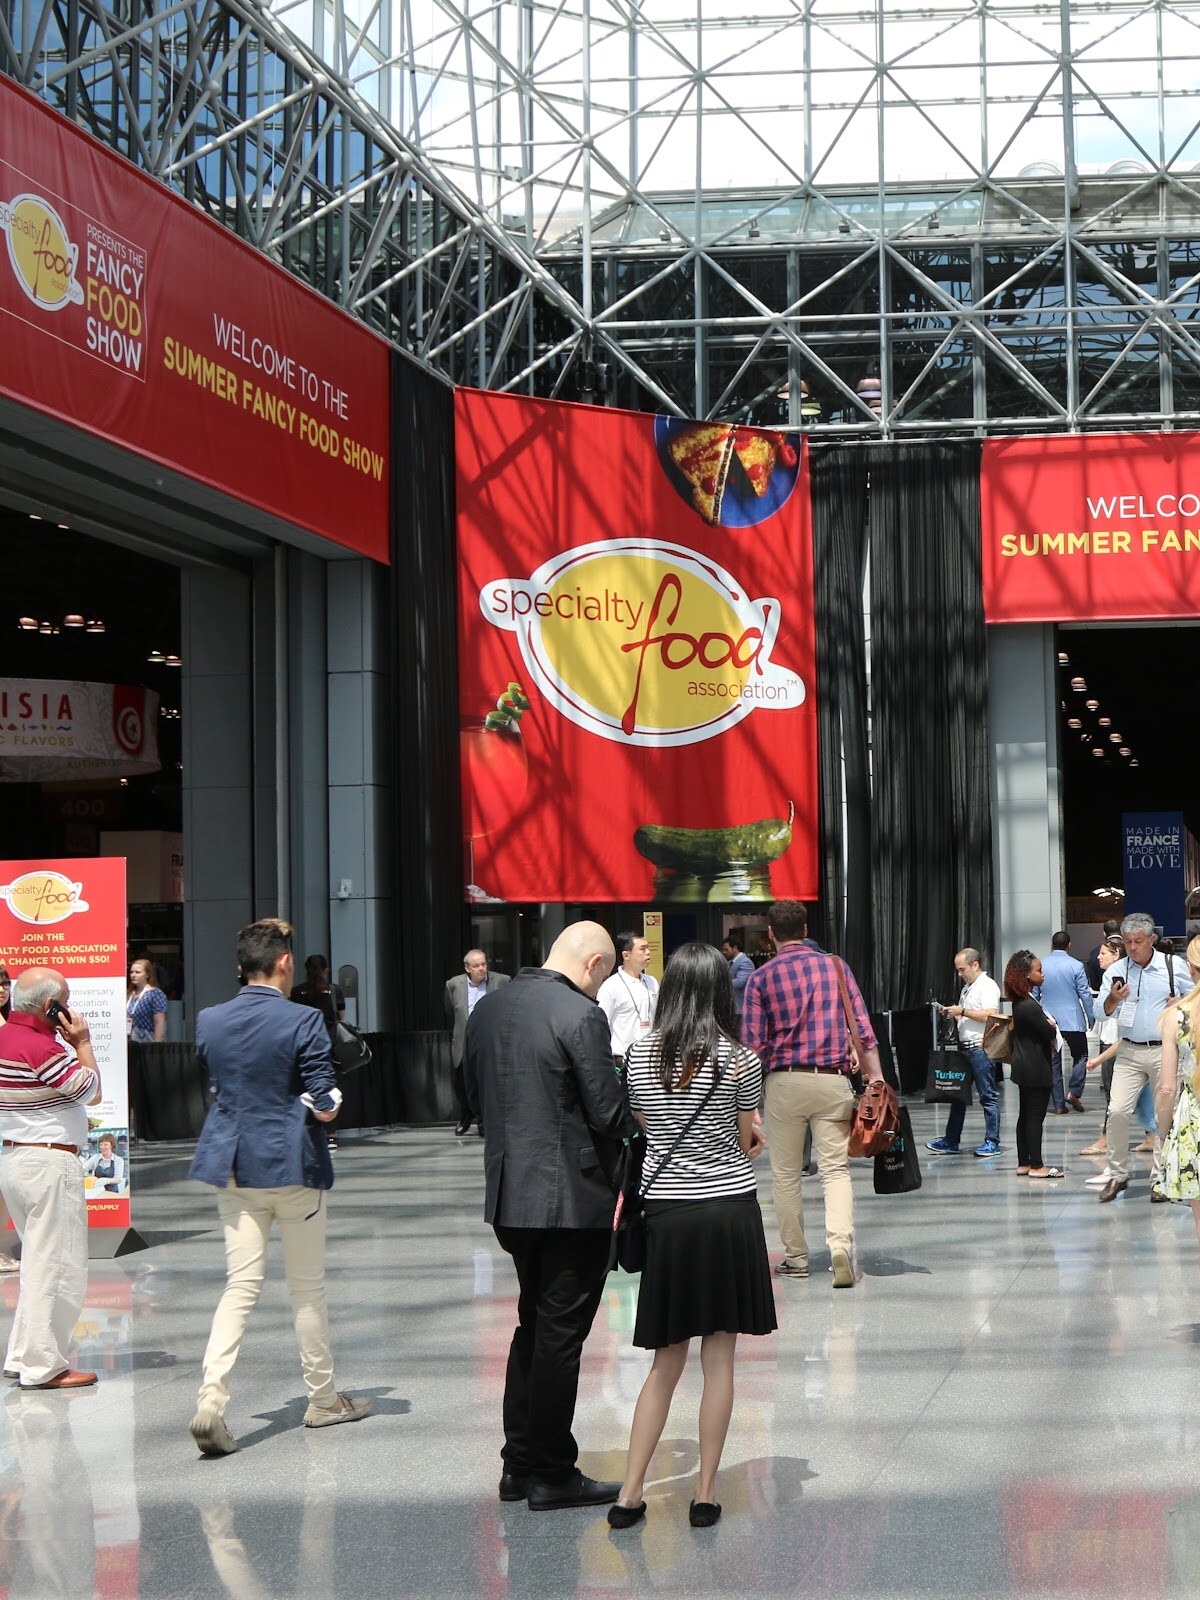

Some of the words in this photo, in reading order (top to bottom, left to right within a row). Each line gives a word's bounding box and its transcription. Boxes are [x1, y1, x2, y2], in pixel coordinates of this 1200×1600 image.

[87, 223, 126, 259] PRESENTS
[128, 249, 143, 269] THE
[34, 219, 76, 298] food
[87, 241, 143, 300] FANCY
[87, 276, 141, 336] FOOD
[87, 316, 142, 371] SHOW
[213, 312, 295, 390] WELCOME
[299, 365, 318, 401] TO
[322, 380, 348, 420] THE
[164, 336, 237, 405] SUMMER
[243, 379, 296, 434] FANCY
[299, 411, 339, 457] FOOD
[343, 436, 384, 481] SHOW
[1000, 531, 1131, 557] SUMMER
[491, 586, 645, 630] specialty
[621, 572, 772, 735] food
[14, 736, 74, 746] FLAVORS
[1126, 827, 1160, 835] MADE
[1168, 826, 1180, 834] IN
[1127, 835, 1179, 846] FRANCE
[1127, 846, 1154, 855] MADE
[1157, 846, 1180, 854] WITH
[1129, 854, 1181, 869] LOVE
[0, 885, 41, 896] specialty
[35, 879, 79, 921] food
[46, 933, 65, 941] THE
[22, 946, 50, 954] FOOD
[52, 944, 117, 954] ASSOCIATION
[9, 957, 49, 966] CHANCE
[51, 956, 64, 964] TO
[66, 956, 87, 964] WIN
[89, 955, 110, 964] $50!
[70, 989, 114, 997] nniversary
[69, 999, 108, 1007] sociation
[80, 1010, 99, 1018] ards
[102, 1010, 111, 1018] to
[90, 1021, 110, 1029] bmit
[95, 1032, 112, 1040] and
[92, 1043, 110, 1052] om/
[934, 1069, 966, 1081] Turkey
